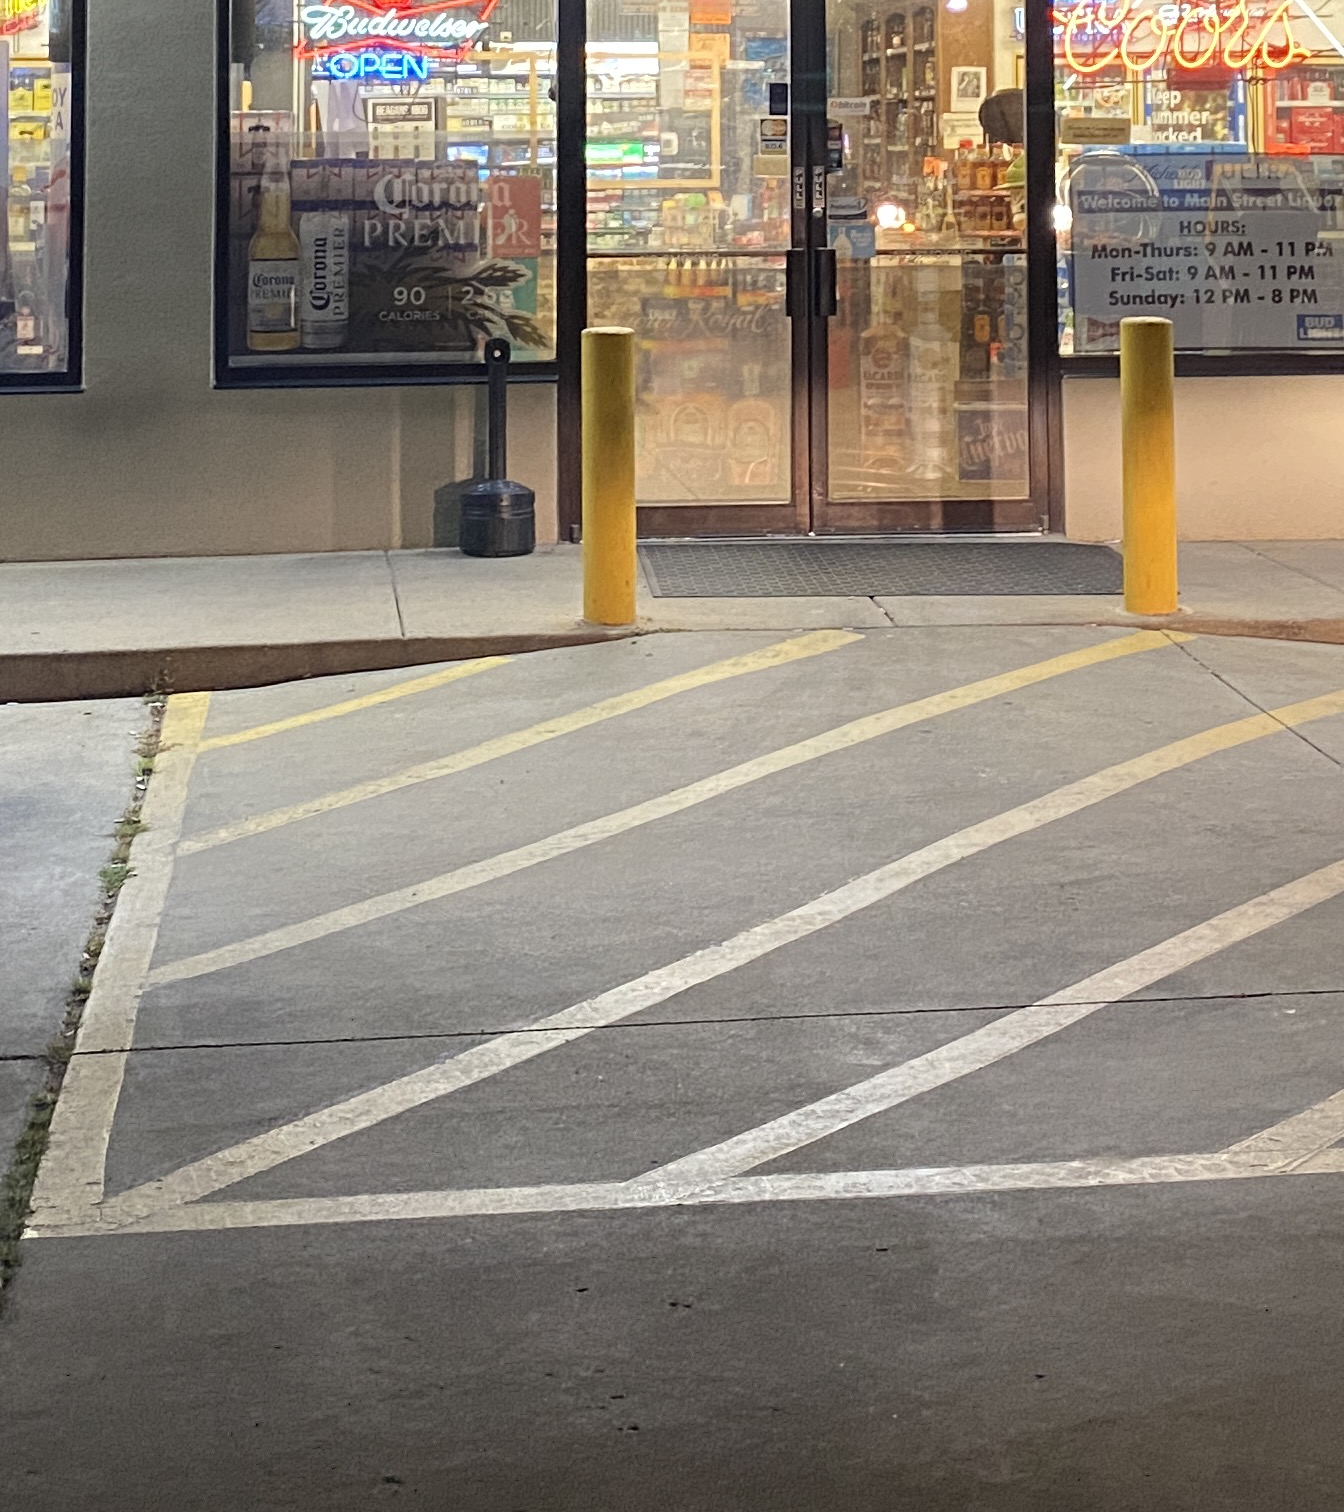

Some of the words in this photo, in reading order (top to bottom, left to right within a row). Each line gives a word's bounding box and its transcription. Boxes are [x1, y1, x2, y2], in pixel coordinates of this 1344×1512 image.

[301, 5, 489, 39] Budweiser
[329, 53, 429, 79] OPEN
[1152, 109, 1211, 125] ummer
[1153, 126, 1203, 143] acked
[373, 172, 513, 218] Corona
[1079, 194, 1157, 210] Welcome
[1163, 195, 1179, 208] to
[1233, 194, 1285, 209] Street
[1288, 193, 1341, 211] Liquor
[363, 219, 532, 247] PREMIER
[1179, 220, 1248, 235] HOURS:
[1091, 243, 1199, 260] Mon-Thurs:
[1205, 241, 1218, 257] 9
[1223, 241, 1254, 257] AM
[1276, 241, 1296, 257] 11
[1305, 240, 1333, 257] PM
[310, 237, 331, 311] Corona
[332, 227, 346, 317] PREMIER
[1111, 266, 1180, 282] Fri-Sat:
[1187, 266, 1198, 281] 9
[1204, 266, 1236, 281] AM
[1257, 265, 1277, 281] 11
[1286, 264, 1316, 280] PM
[393, 287, 426, 305] 90
[1108, 289, 1185, 308] Sunday:
[1193, 289, 1216, 305] 12
[1222, 289, 1251, 304] PM
[1271, 289, 1283, 304] 8
[1289, 288, 1319, 304] PM
[378, 311, 441, 321] CALORIES
[1305, 317, 1335, 329] BUD
